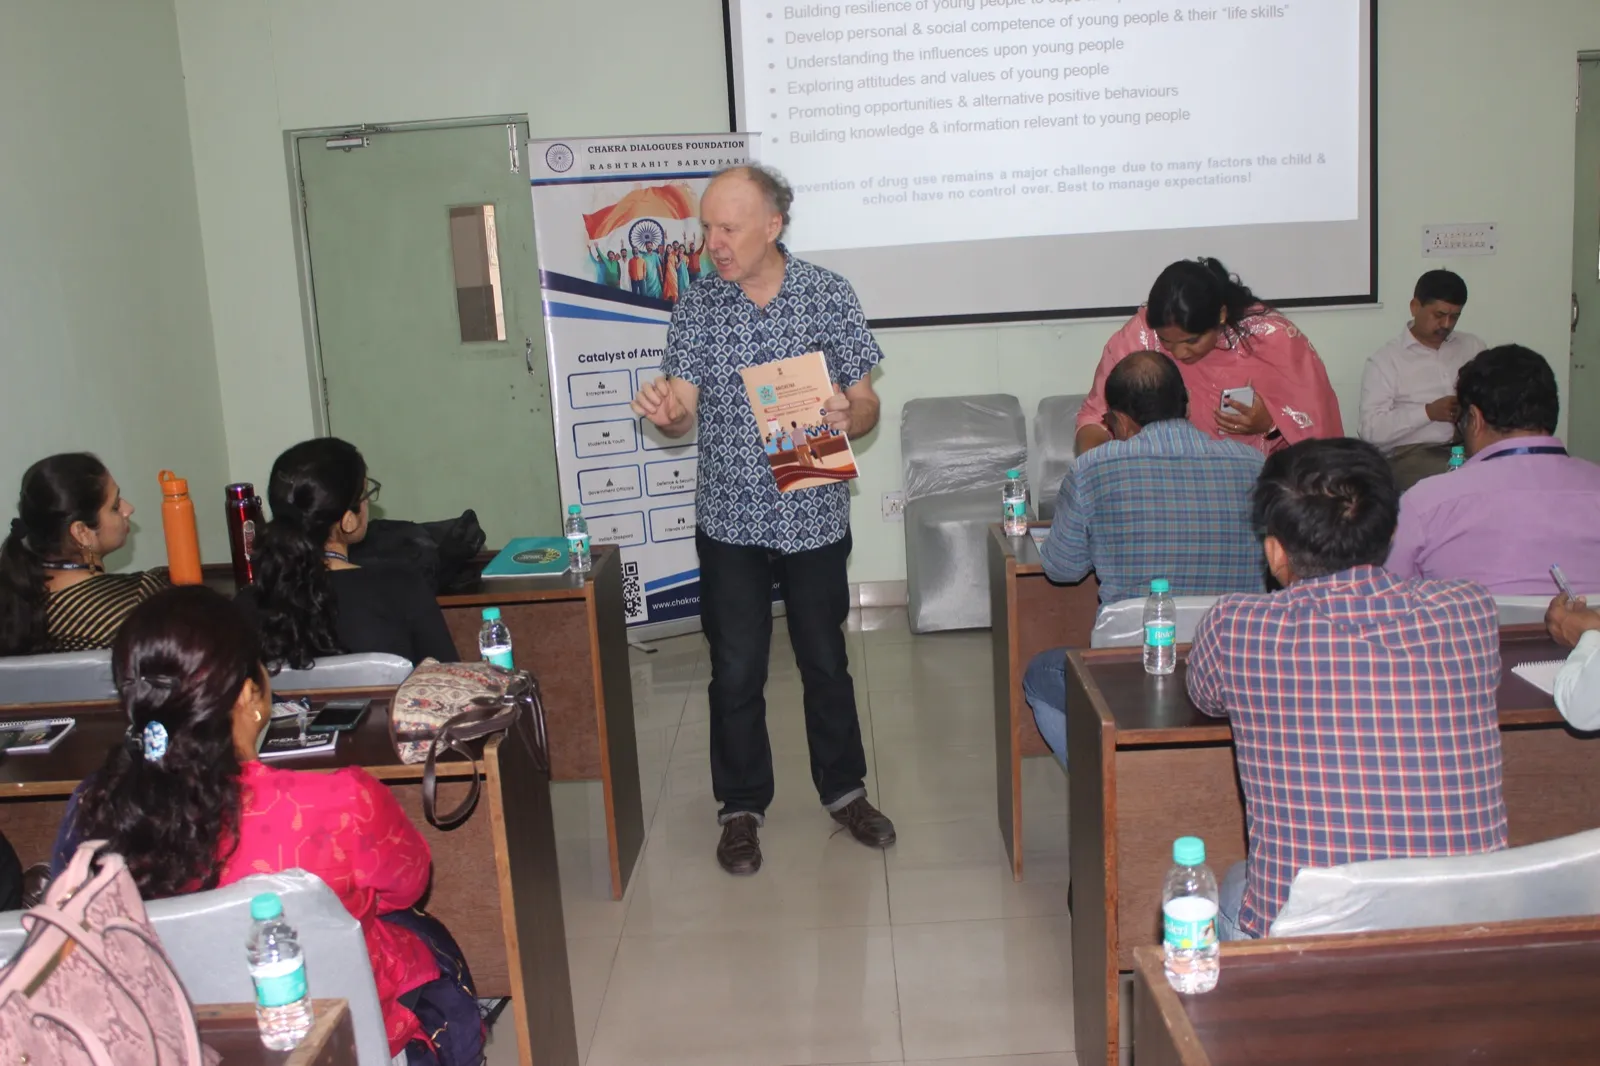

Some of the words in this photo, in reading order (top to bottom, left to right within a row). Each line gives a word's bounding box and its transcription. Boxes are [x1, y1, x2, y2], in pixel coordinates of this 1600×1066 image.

[784, 4, 840, 19] Building
[845, 0, 912, 14] resilience
[916, 0, 928, 10] of
[933, 0, 975, 13] young
[785, 28, 844, 44] Develop
[847, 23, 907, 42] personal
[912, 23, 923, 35] &
[927, 20, 966, 35] social
[970, 18, 1055, 33] competence
[1060, 14, 1073, 27] of
[1077, 15, 1118, 29] young
[1124, 10, 1169, 27] people
[1174, 9, 1184, 21] &
[1188, 8, 1217, 21] their
[787, 51, 888, 70] Understanding
[893, 49, 914, 62] the
[919, 47, 989, 60] influences
[994, 45, 1027, 58] upon
[1032, 42, 1074, 57] young
[1079, 37, 1124, 54] people
[787, 79, 854, 96] Exploring
[857, 74, 916, 89] attitudes
[921, 71, 946, 84] and
[951, 70, 995, 83] values
[1000, 67, 1013, 80] of
[1017, 68, 1058, 82] young
[1064, 63, 1109, 80] people
[788, 103, 861, 120] Promoting
[864, 97, 952, 116] opportunities
[957, 96, 968, 108] &
[973, 92, 1044, 107] alternative
[1048, 89, 1100, 105] positive
[1105, 87, 1179, 99] behaviours
[790, 129, 846, 144] Building
[850, 123, 924, 139] knowledge
[929, 121, 939, 134] &
[943, 117, 1020, 133] information
[1024, 114, 1078, 129] relevant
[1083, 113, 1096, 125] to
[1099, 113, 1140, 127] young
[1145, 108, 1190, 124] people
[587, 145, 628, 154] CHAKRA
[630, 142, 683, 152] DIALOGUES
[686, 140, 745, 150] FOUNDATION
[589, 160, 669, 170] RASHTRAHIT
[677, 158, 745, 167] SARVOPARI
[791, 178, 856, 195] revention
[860, 177, 874, 189] of
[878, 176, 908, 189] drug
[913, 175, 937, 185] use
[942, 170, 994, 183] remains
[1000, 171, 1007, 180] a
[1012, 167, 1048, 180] major
[1053, 164, 1116, 177] challenge
[1122, 161, 1146, 173] due
[1150, 161, 1163, 172] to
[1167, 161, 1202, 172] many
[1208, 157, 1252, 168] factors
[1257, 155, 1277, 166] the
[1281, 153, 1312, 165] child
[1317, 153, 1326, 164] &
[862, 191, 907, 205] school
[912, 190, 944, 201] have
[948, 190, 964, 199] no
[969, 184, 1016, 198] control
[1021, 185, 1053, 194] over.
[1057, 182, 1087, 192] Best
[1092, 181, 1104, 191] to
[1109, 179, 1160, 191] manage
[1164, 172, 1251, 189] expectations!
[578, 350, 626, 364] Catalyst
[627, 348, 638, 359] of
[640, 347, 666, 358] Atm
